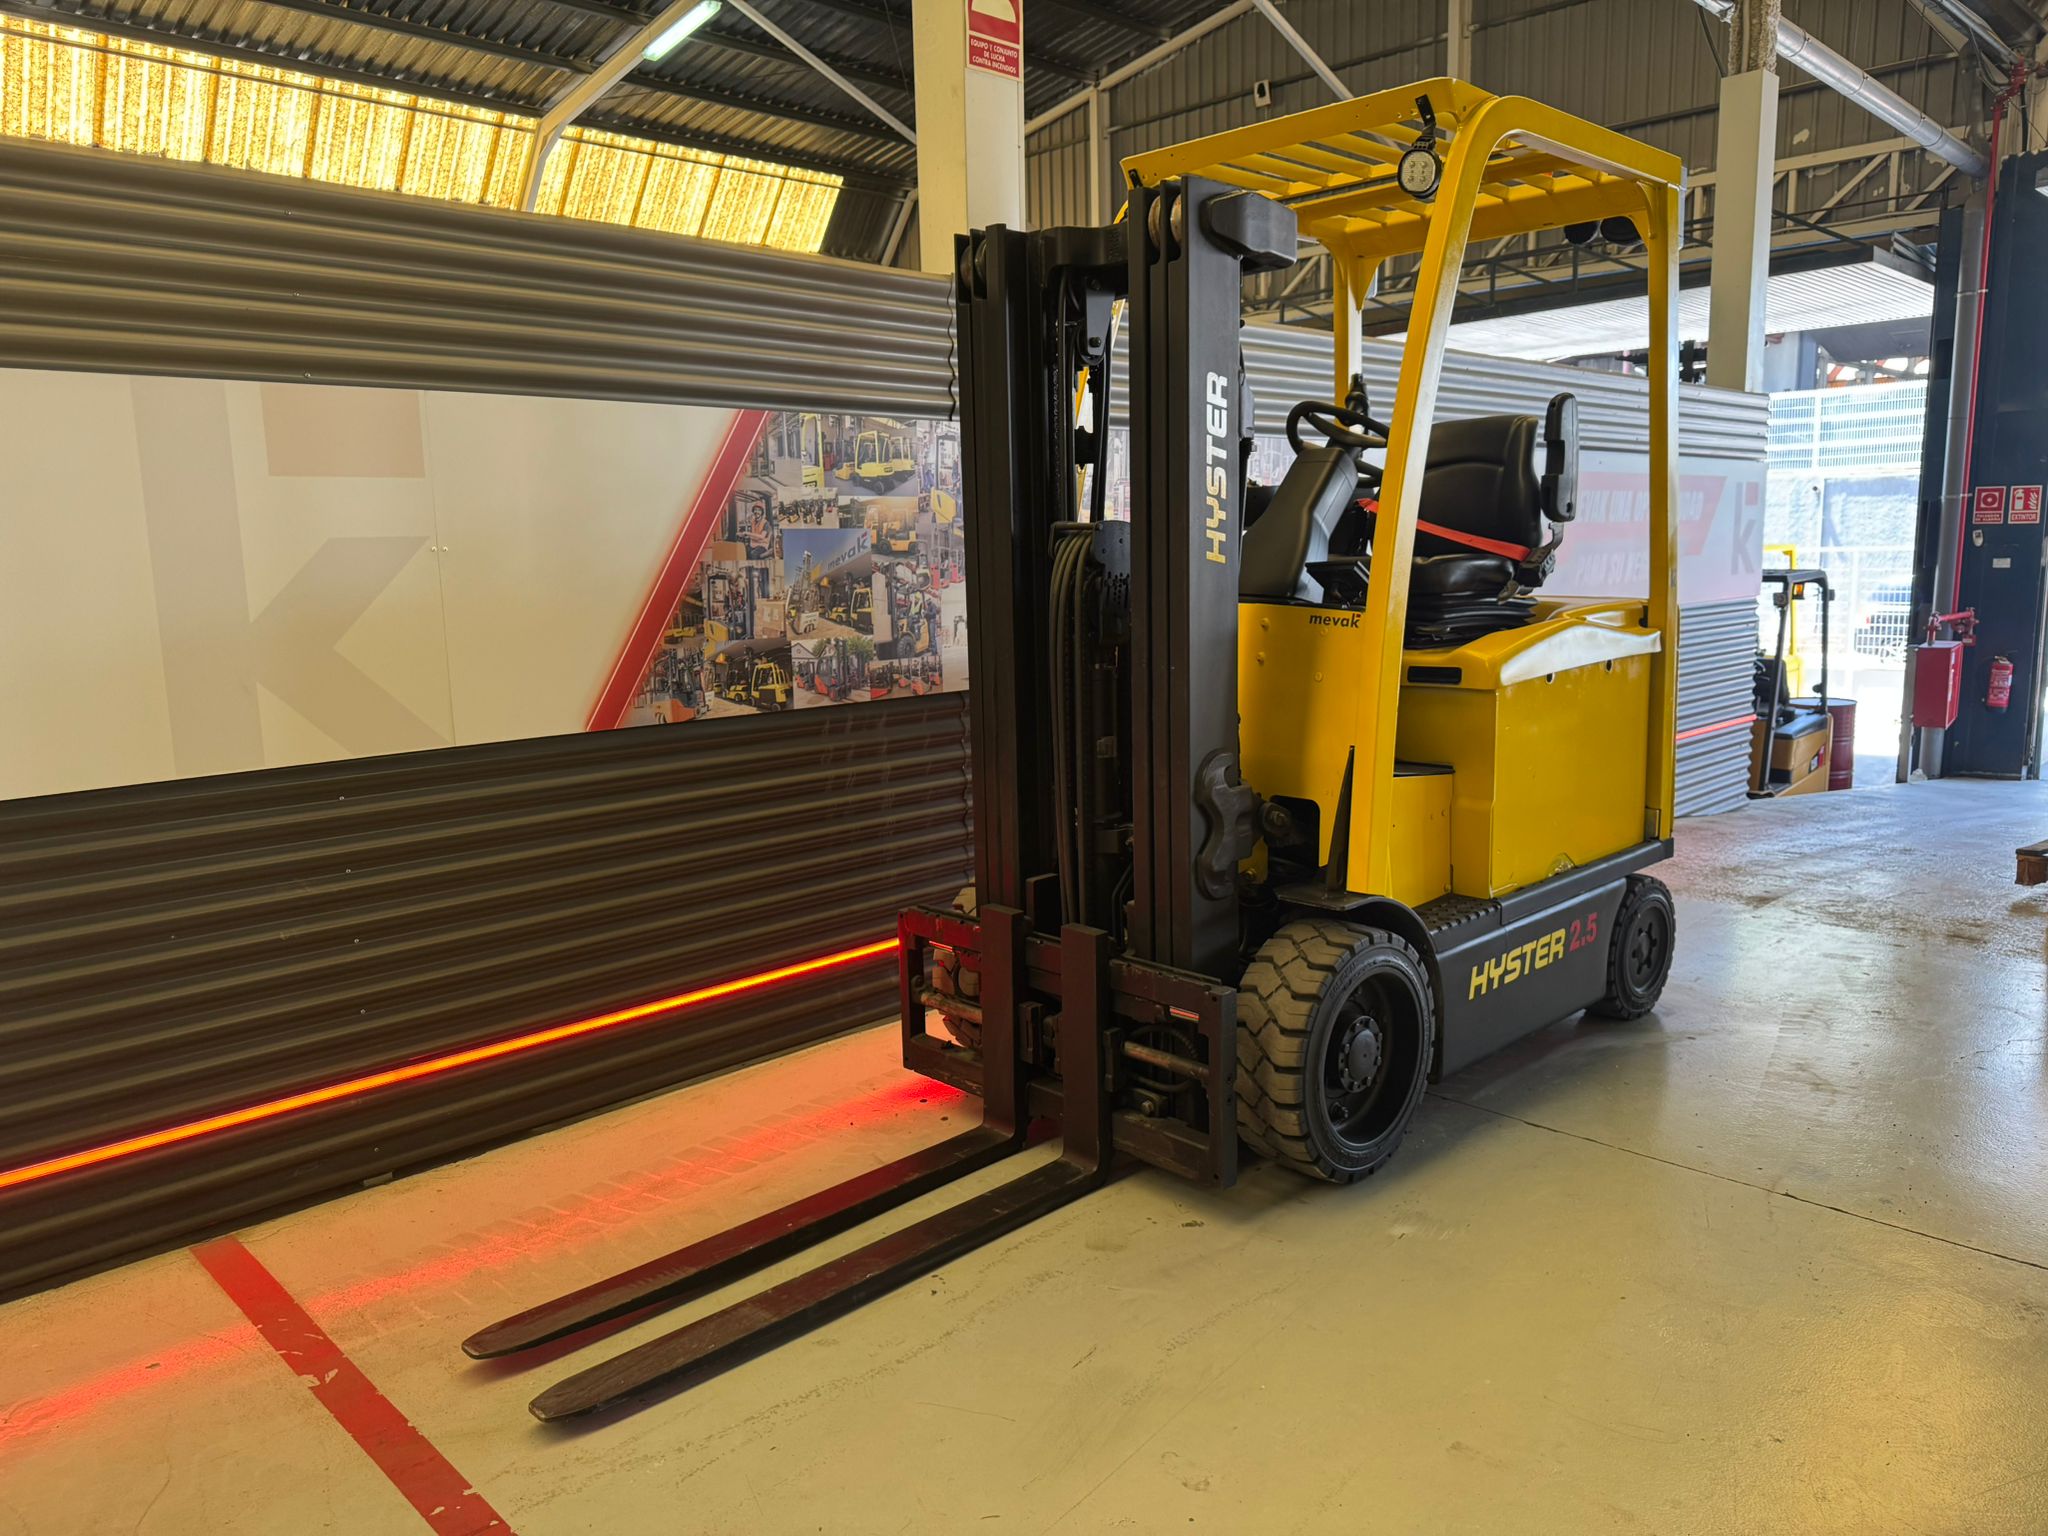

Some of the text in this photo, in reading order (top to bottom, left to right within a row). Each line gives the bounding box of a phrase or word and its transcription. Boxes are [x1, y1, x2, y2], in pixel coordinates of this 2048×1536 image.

[970, 38, 988, 49] EQUIPO
[993, 46, 1017, 58] CONJUNTO
[983, 50, 1006, 62] DE LUCHA
[972, 56, 1016, 73] CONTRA INCENDIOS
[1206, 371, 1228, 564] HYSTER
[2011, 513, 2037, 521] EXTINTOR
[1309, 613, 1361, 628] mevak
[1469, 912, 1598, 1000] HYSTER 2.5
